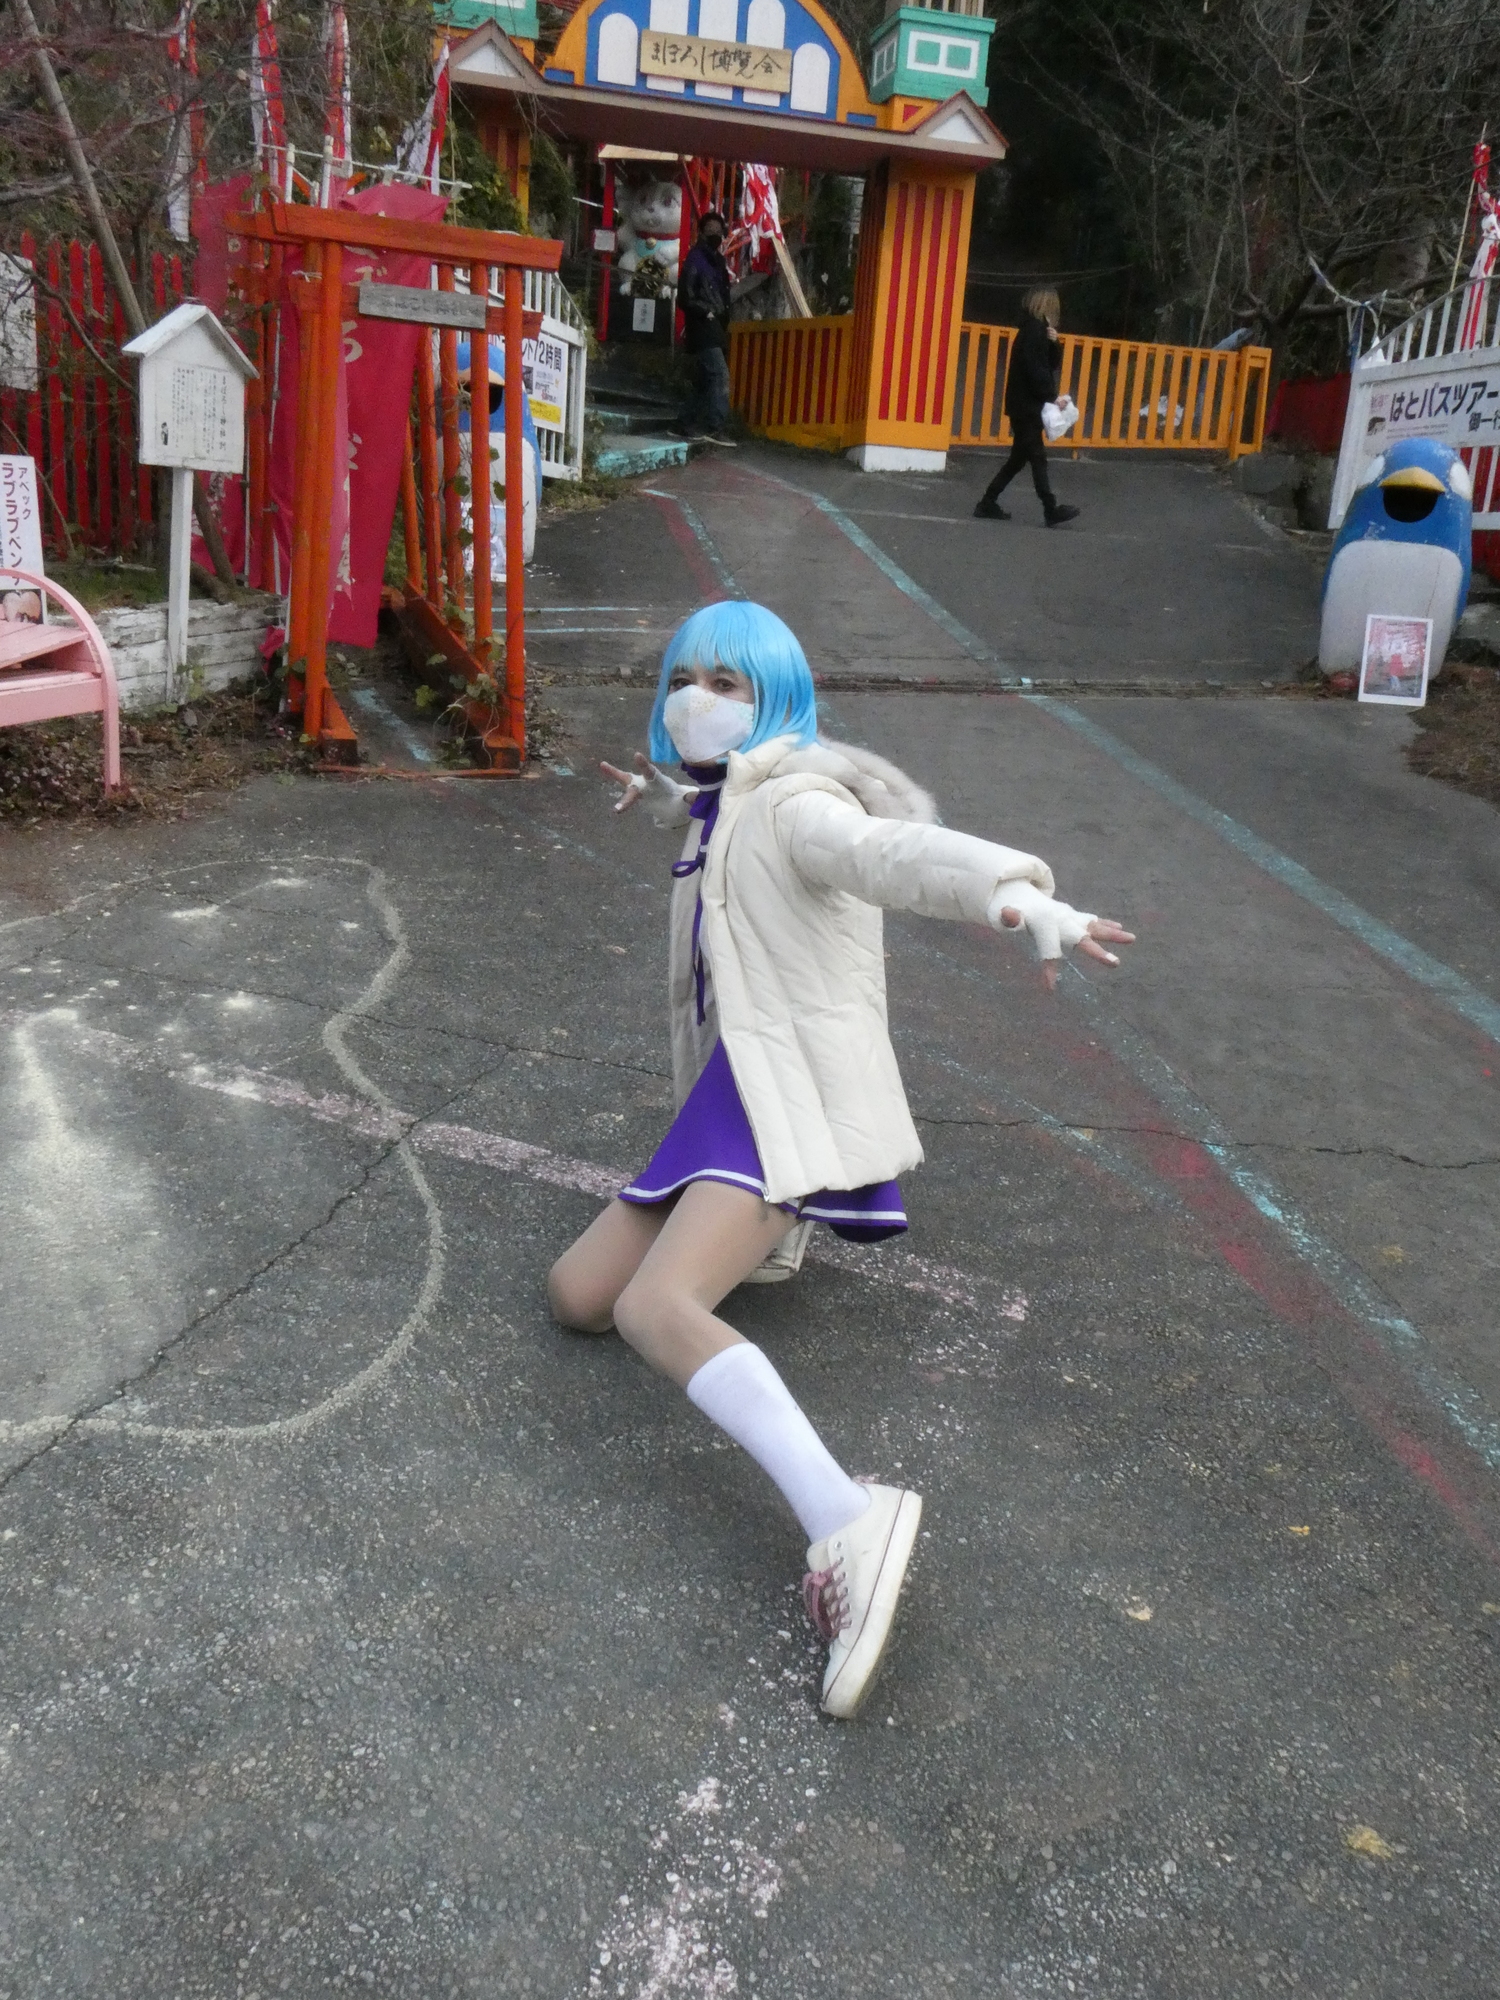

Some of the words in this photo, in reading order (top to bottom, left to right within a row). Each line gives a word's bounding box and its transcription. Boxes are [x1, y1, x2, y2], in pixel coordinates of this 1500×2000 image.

[650, 38, 783, 80] まぼろし博覧会
[1389, 381, 1499, 422] はとバスツアー
[18, 466, 32, 520] アベック
